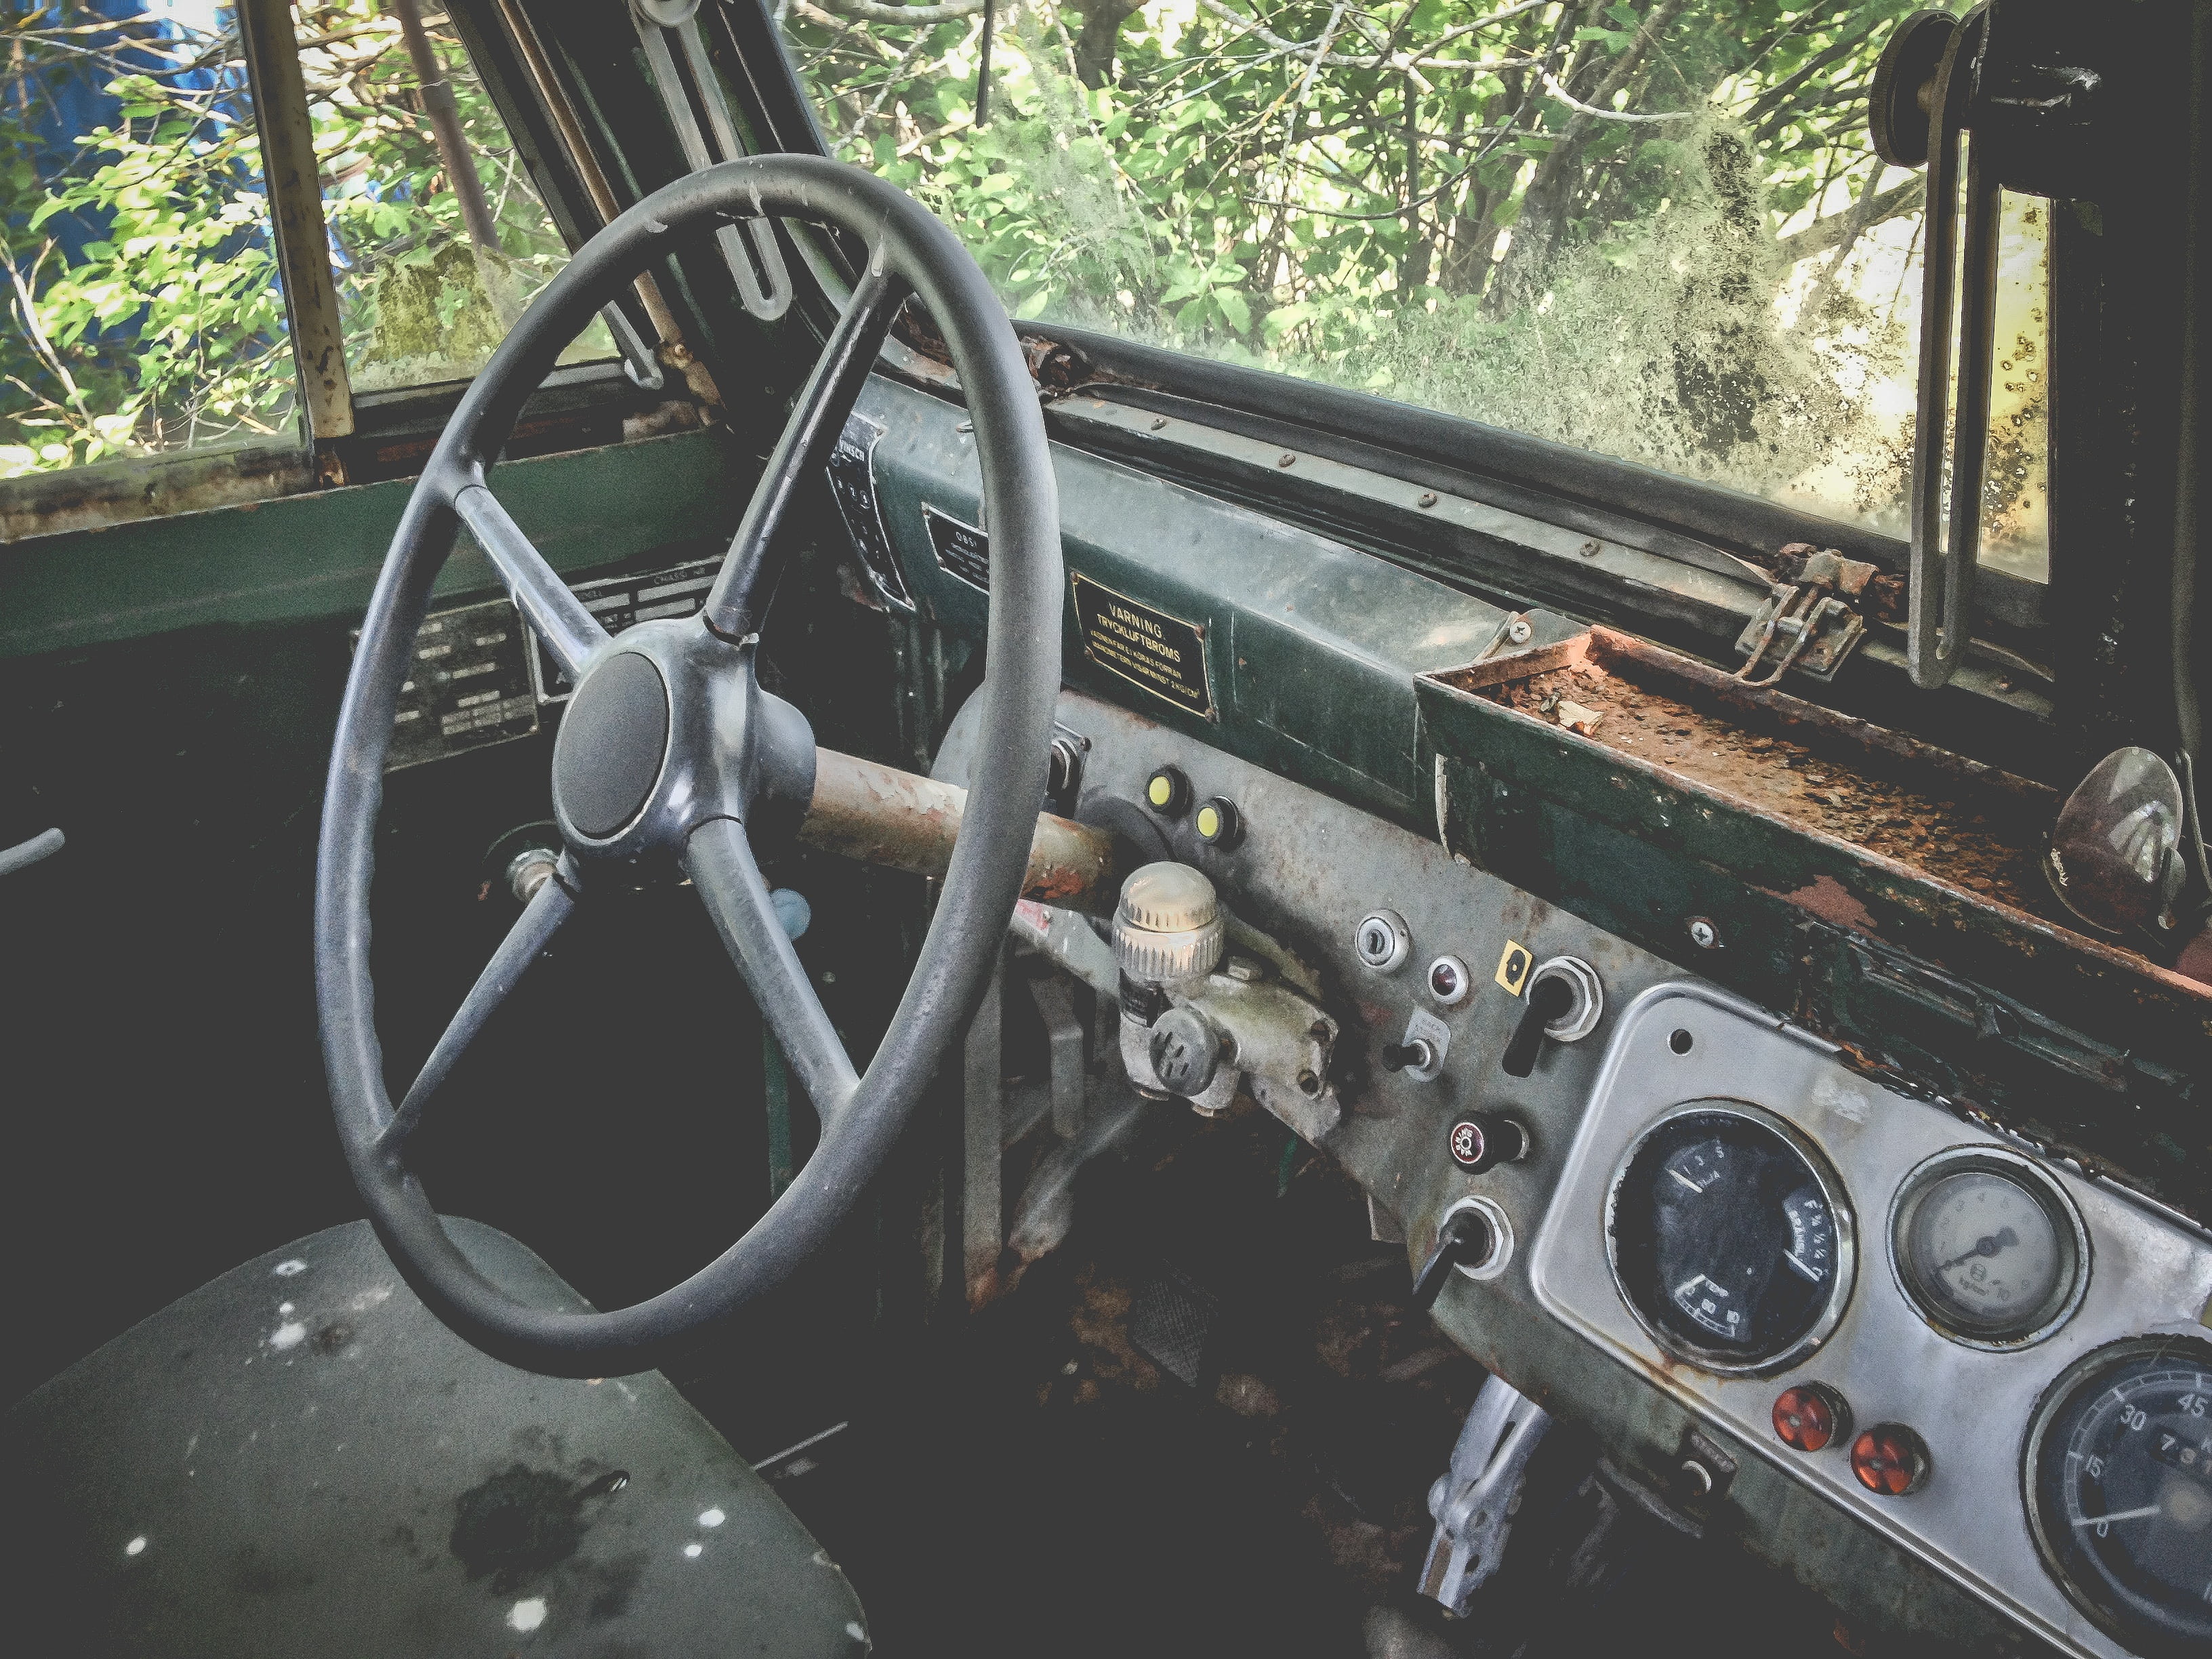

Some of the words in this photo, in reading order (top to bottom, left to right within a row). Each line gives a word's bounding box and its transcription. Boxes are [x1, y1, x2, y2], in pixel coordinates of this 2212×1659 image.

[1109, 602, 1162, 638] VARNING
[1097, 613, 1181, 663] TRYCKLUFTBROMS
[2120, 1403, 2148, 1431] 30
[2177, 1393, 2209, 1418] 45
[2085, 1454, 2105, 1479] 15
[2096, 1521, 2110, 1538] 0
